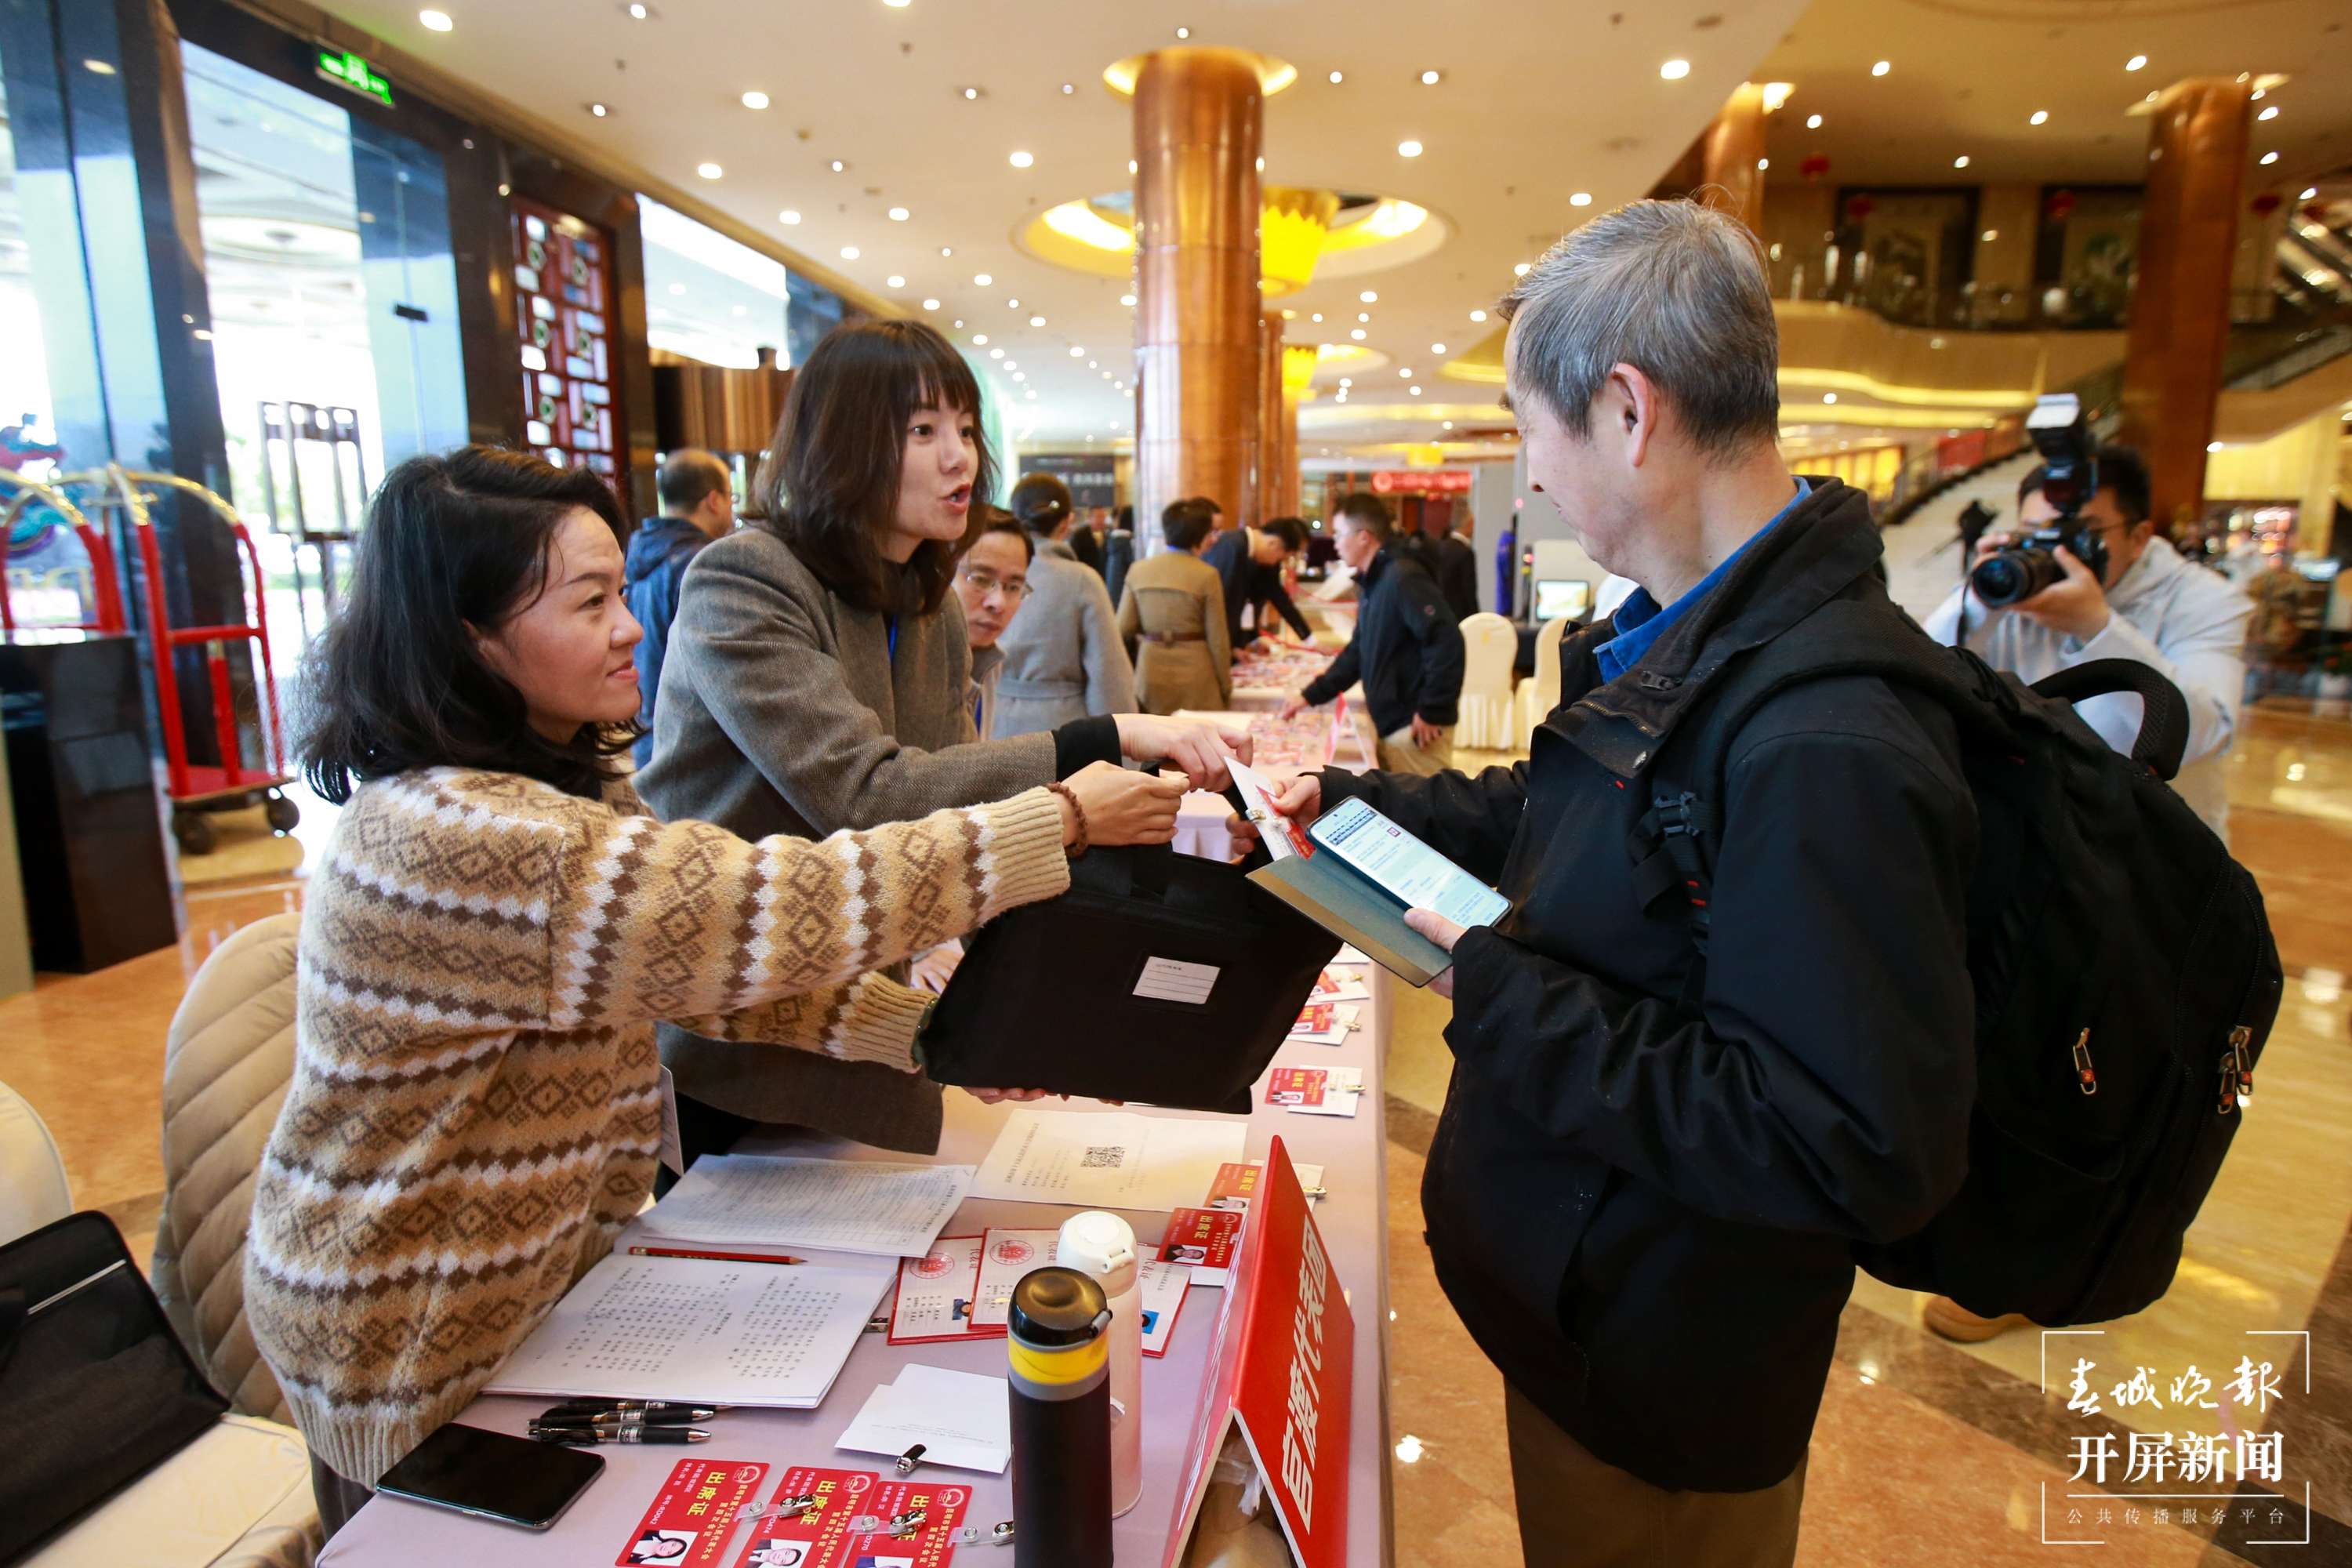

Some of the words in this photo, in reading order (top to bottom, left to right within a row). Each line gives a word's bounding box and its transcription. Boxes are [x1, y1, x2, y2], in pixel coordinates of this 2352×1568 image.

[1282, 1213, 1327, 1535] 官渡代表团
[687, 1471, 727, 1516] 出席证
